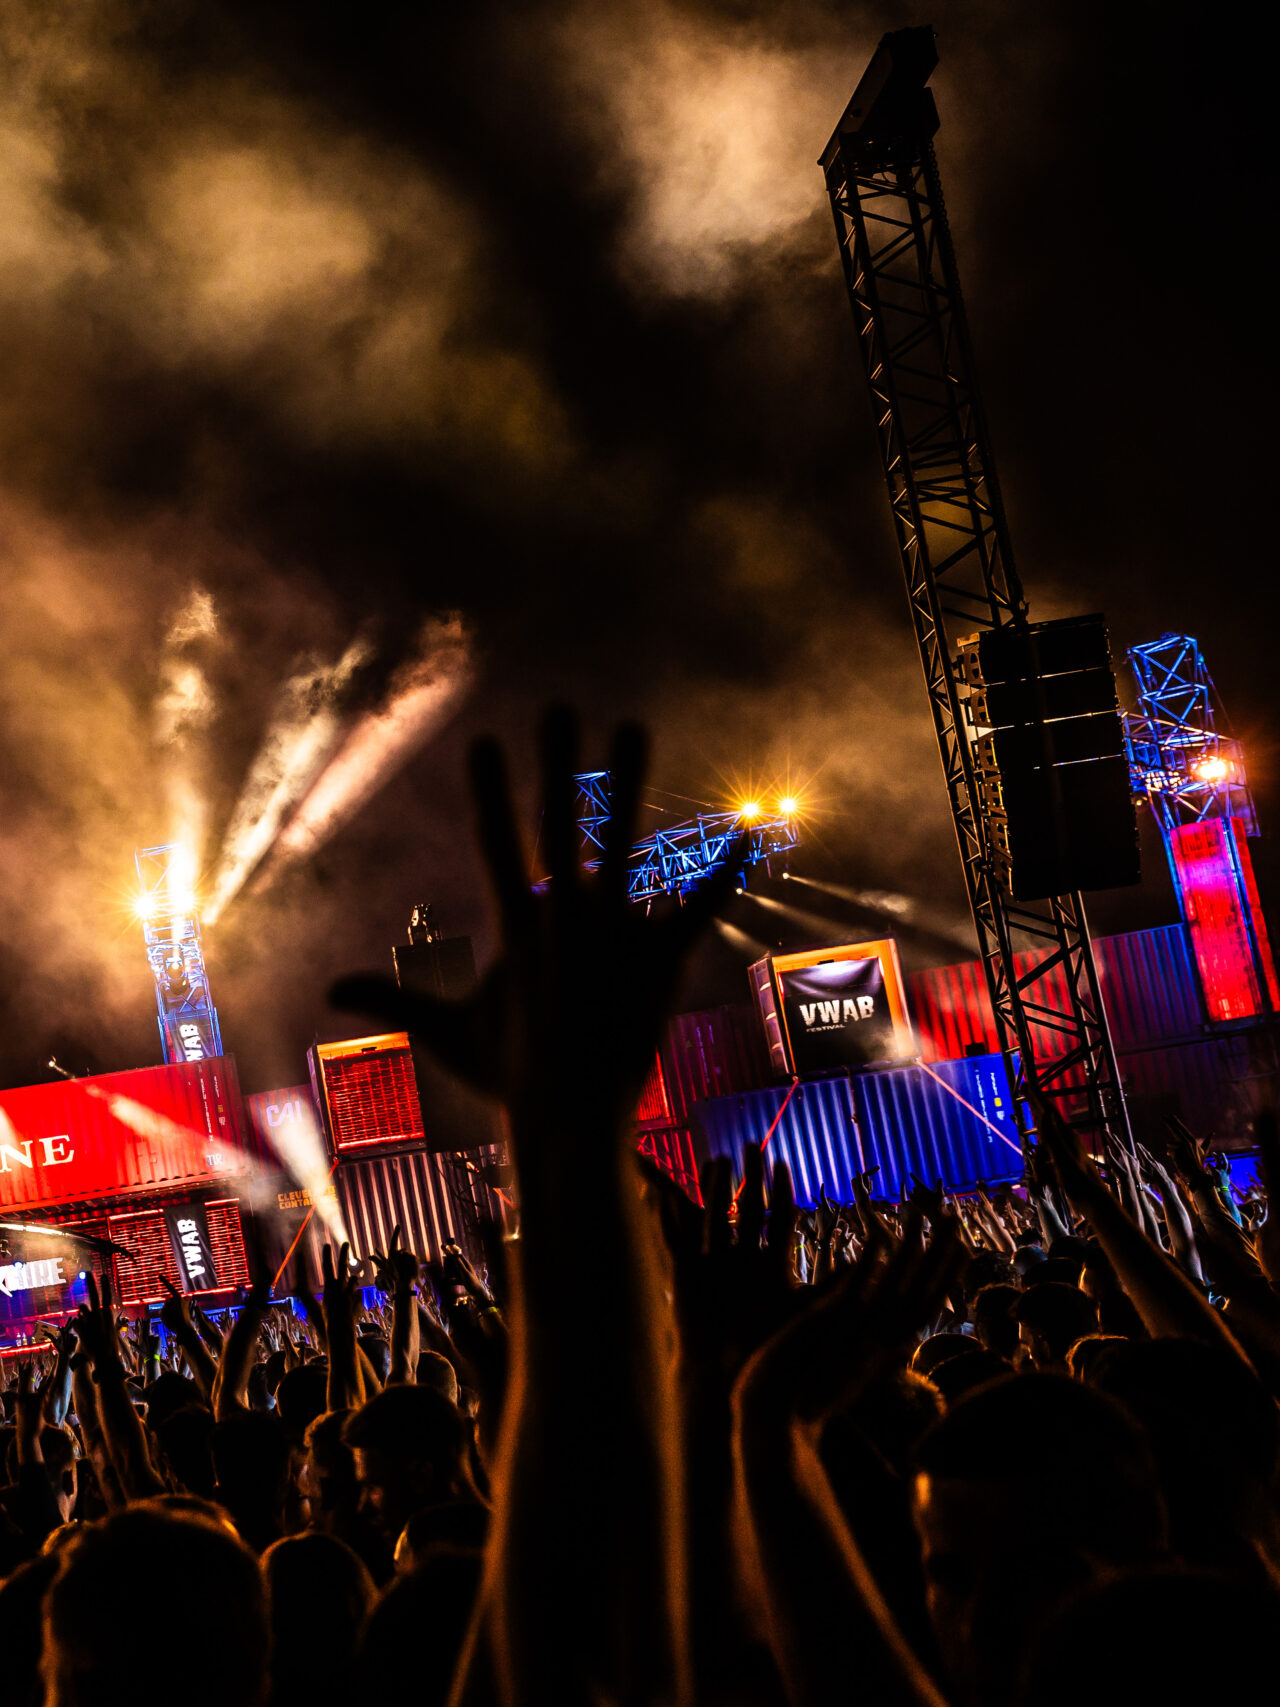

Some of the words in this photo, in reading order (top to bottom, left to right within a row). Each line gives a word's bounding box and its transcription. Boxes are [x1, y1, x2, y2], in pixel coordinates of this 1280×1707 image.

[799, 995, 875, 1027] VWAB
[180, 1024, 204, 1062] WAB
[805, 1024, 846, 1033] FESTIVAL
[266, 1100, 303, 1127] CAI
[177, 1218, 206, 1279] VWAB
